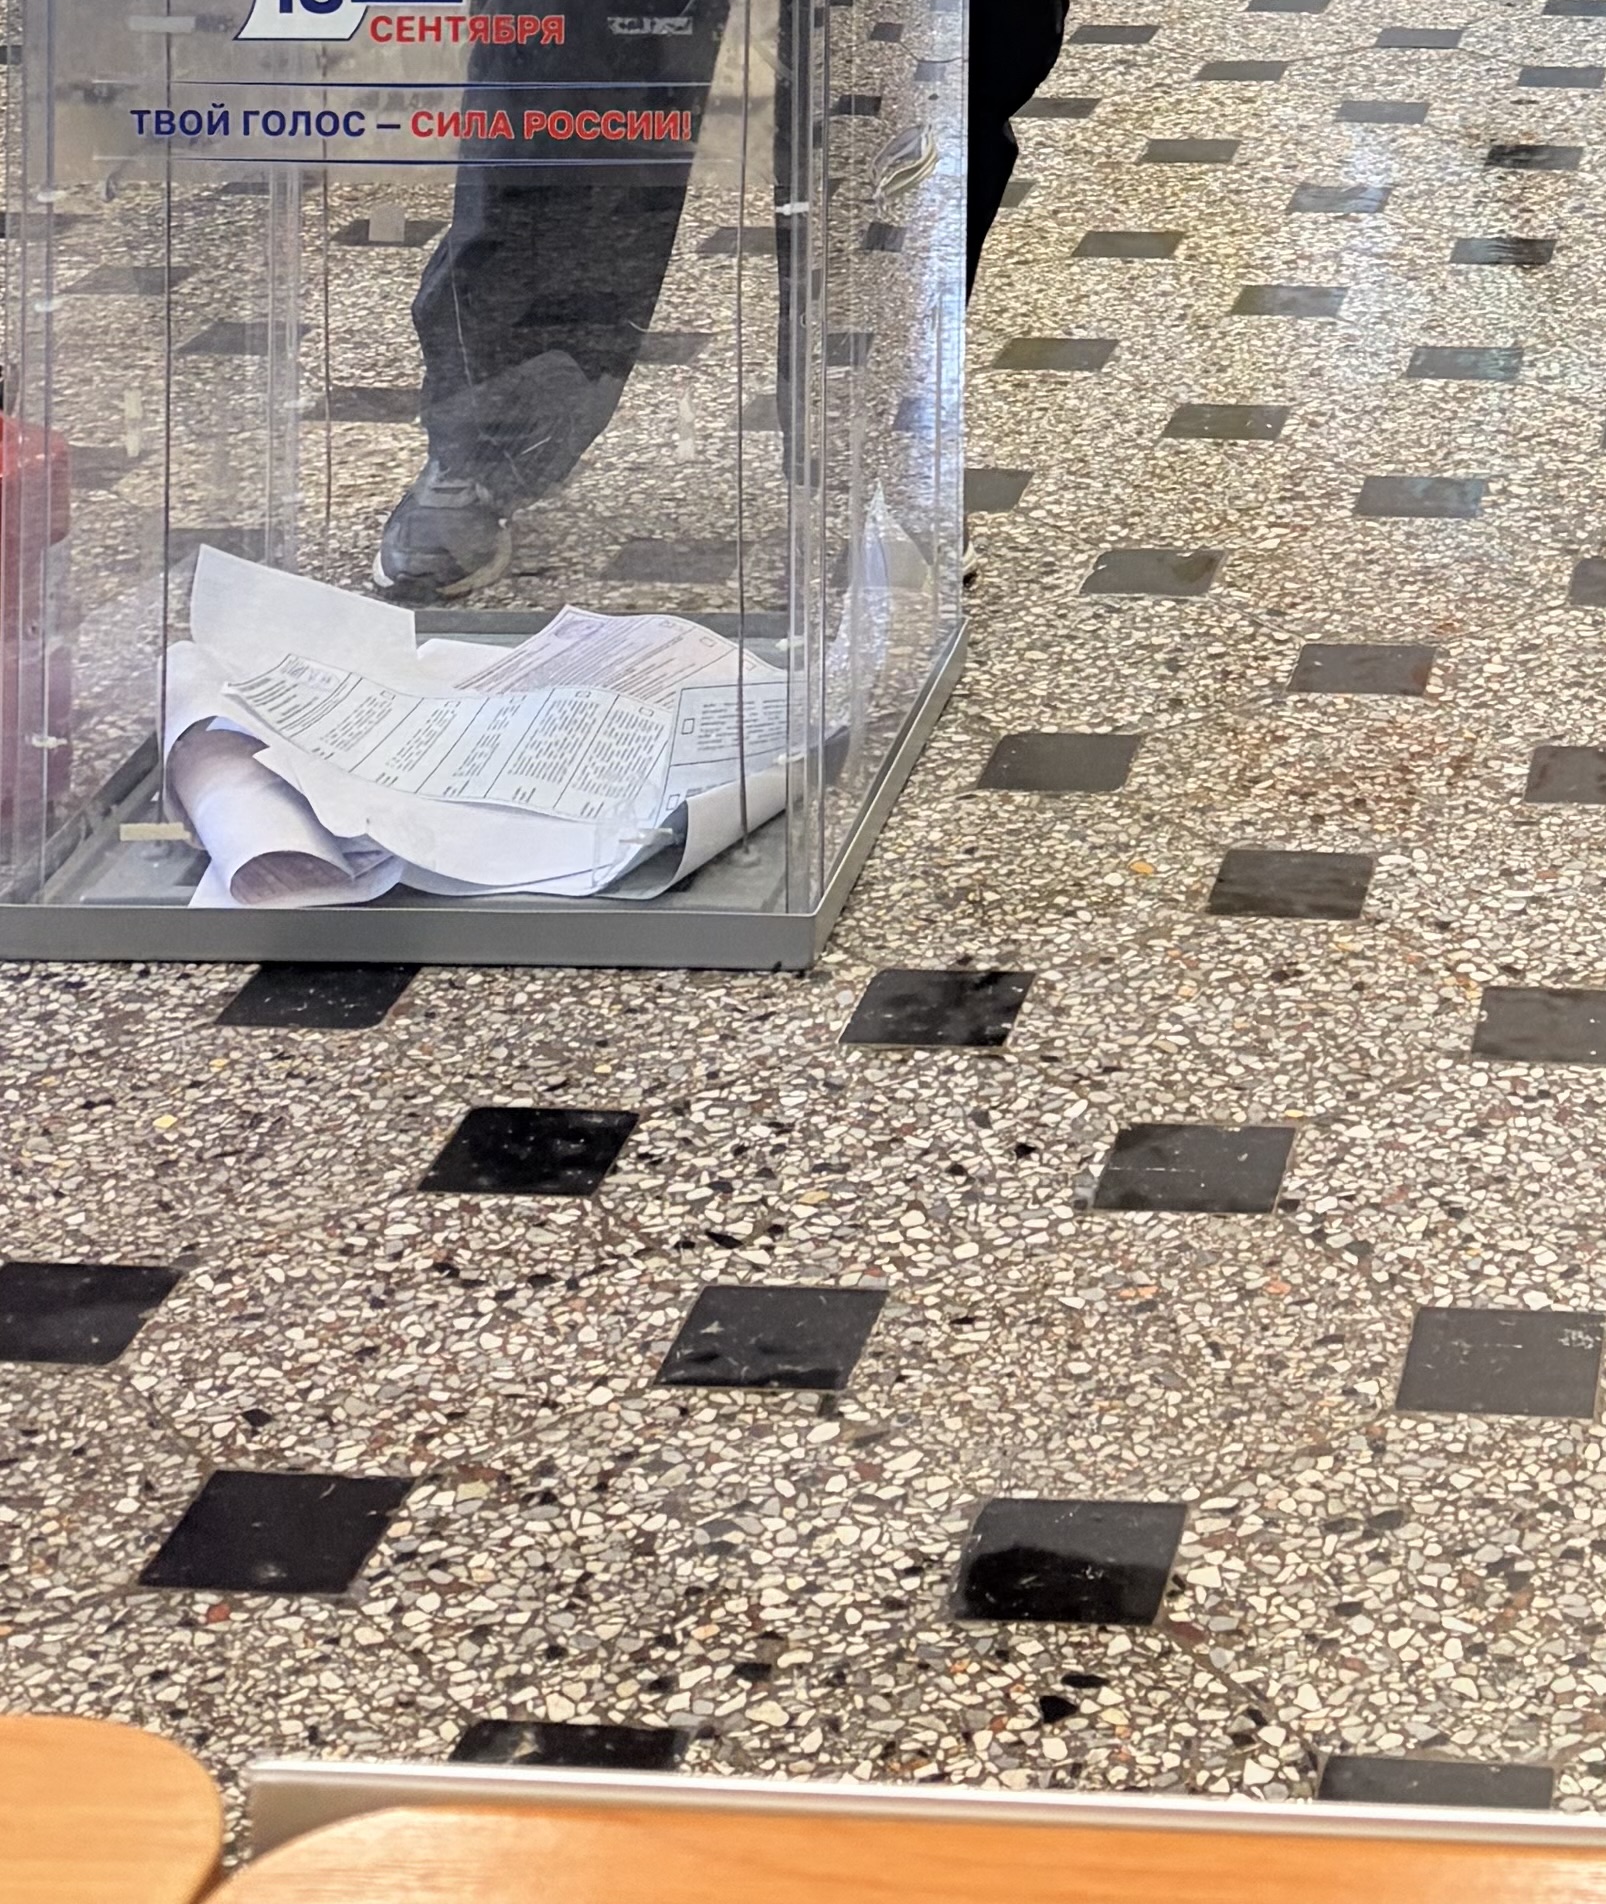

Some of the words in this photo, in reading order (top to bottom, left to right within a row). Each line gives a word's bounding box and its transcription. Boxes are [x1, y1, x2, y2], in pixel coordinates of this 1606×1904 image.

[369, 15, 565, 45] СЕНТЯБРЯ
[130, 103, 230, 136] ТВОЙ
[242, 110, 365, 137] ГОЛОС
[410, 111, 515, 139] СИЛА
[524, 111, 692, 140] РОССИИ!
